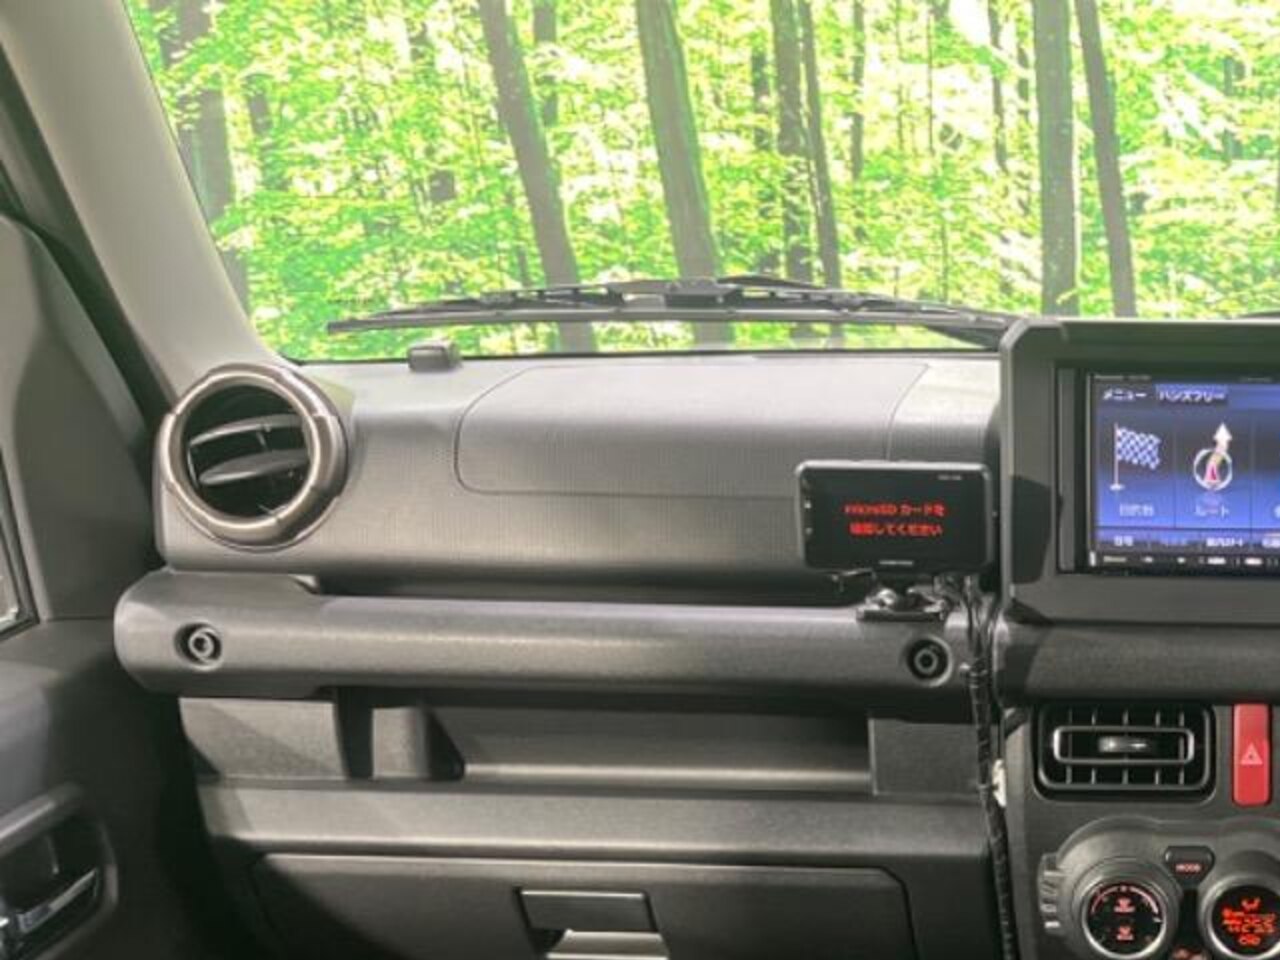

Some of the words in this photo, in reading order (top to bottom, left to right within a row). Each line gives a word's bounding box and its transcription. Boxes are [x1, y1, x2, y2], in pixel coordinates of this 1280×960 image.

[1103, 389, 1147, 401] メニュー
[1158, 390, 1226, 403] ハンズフリー
